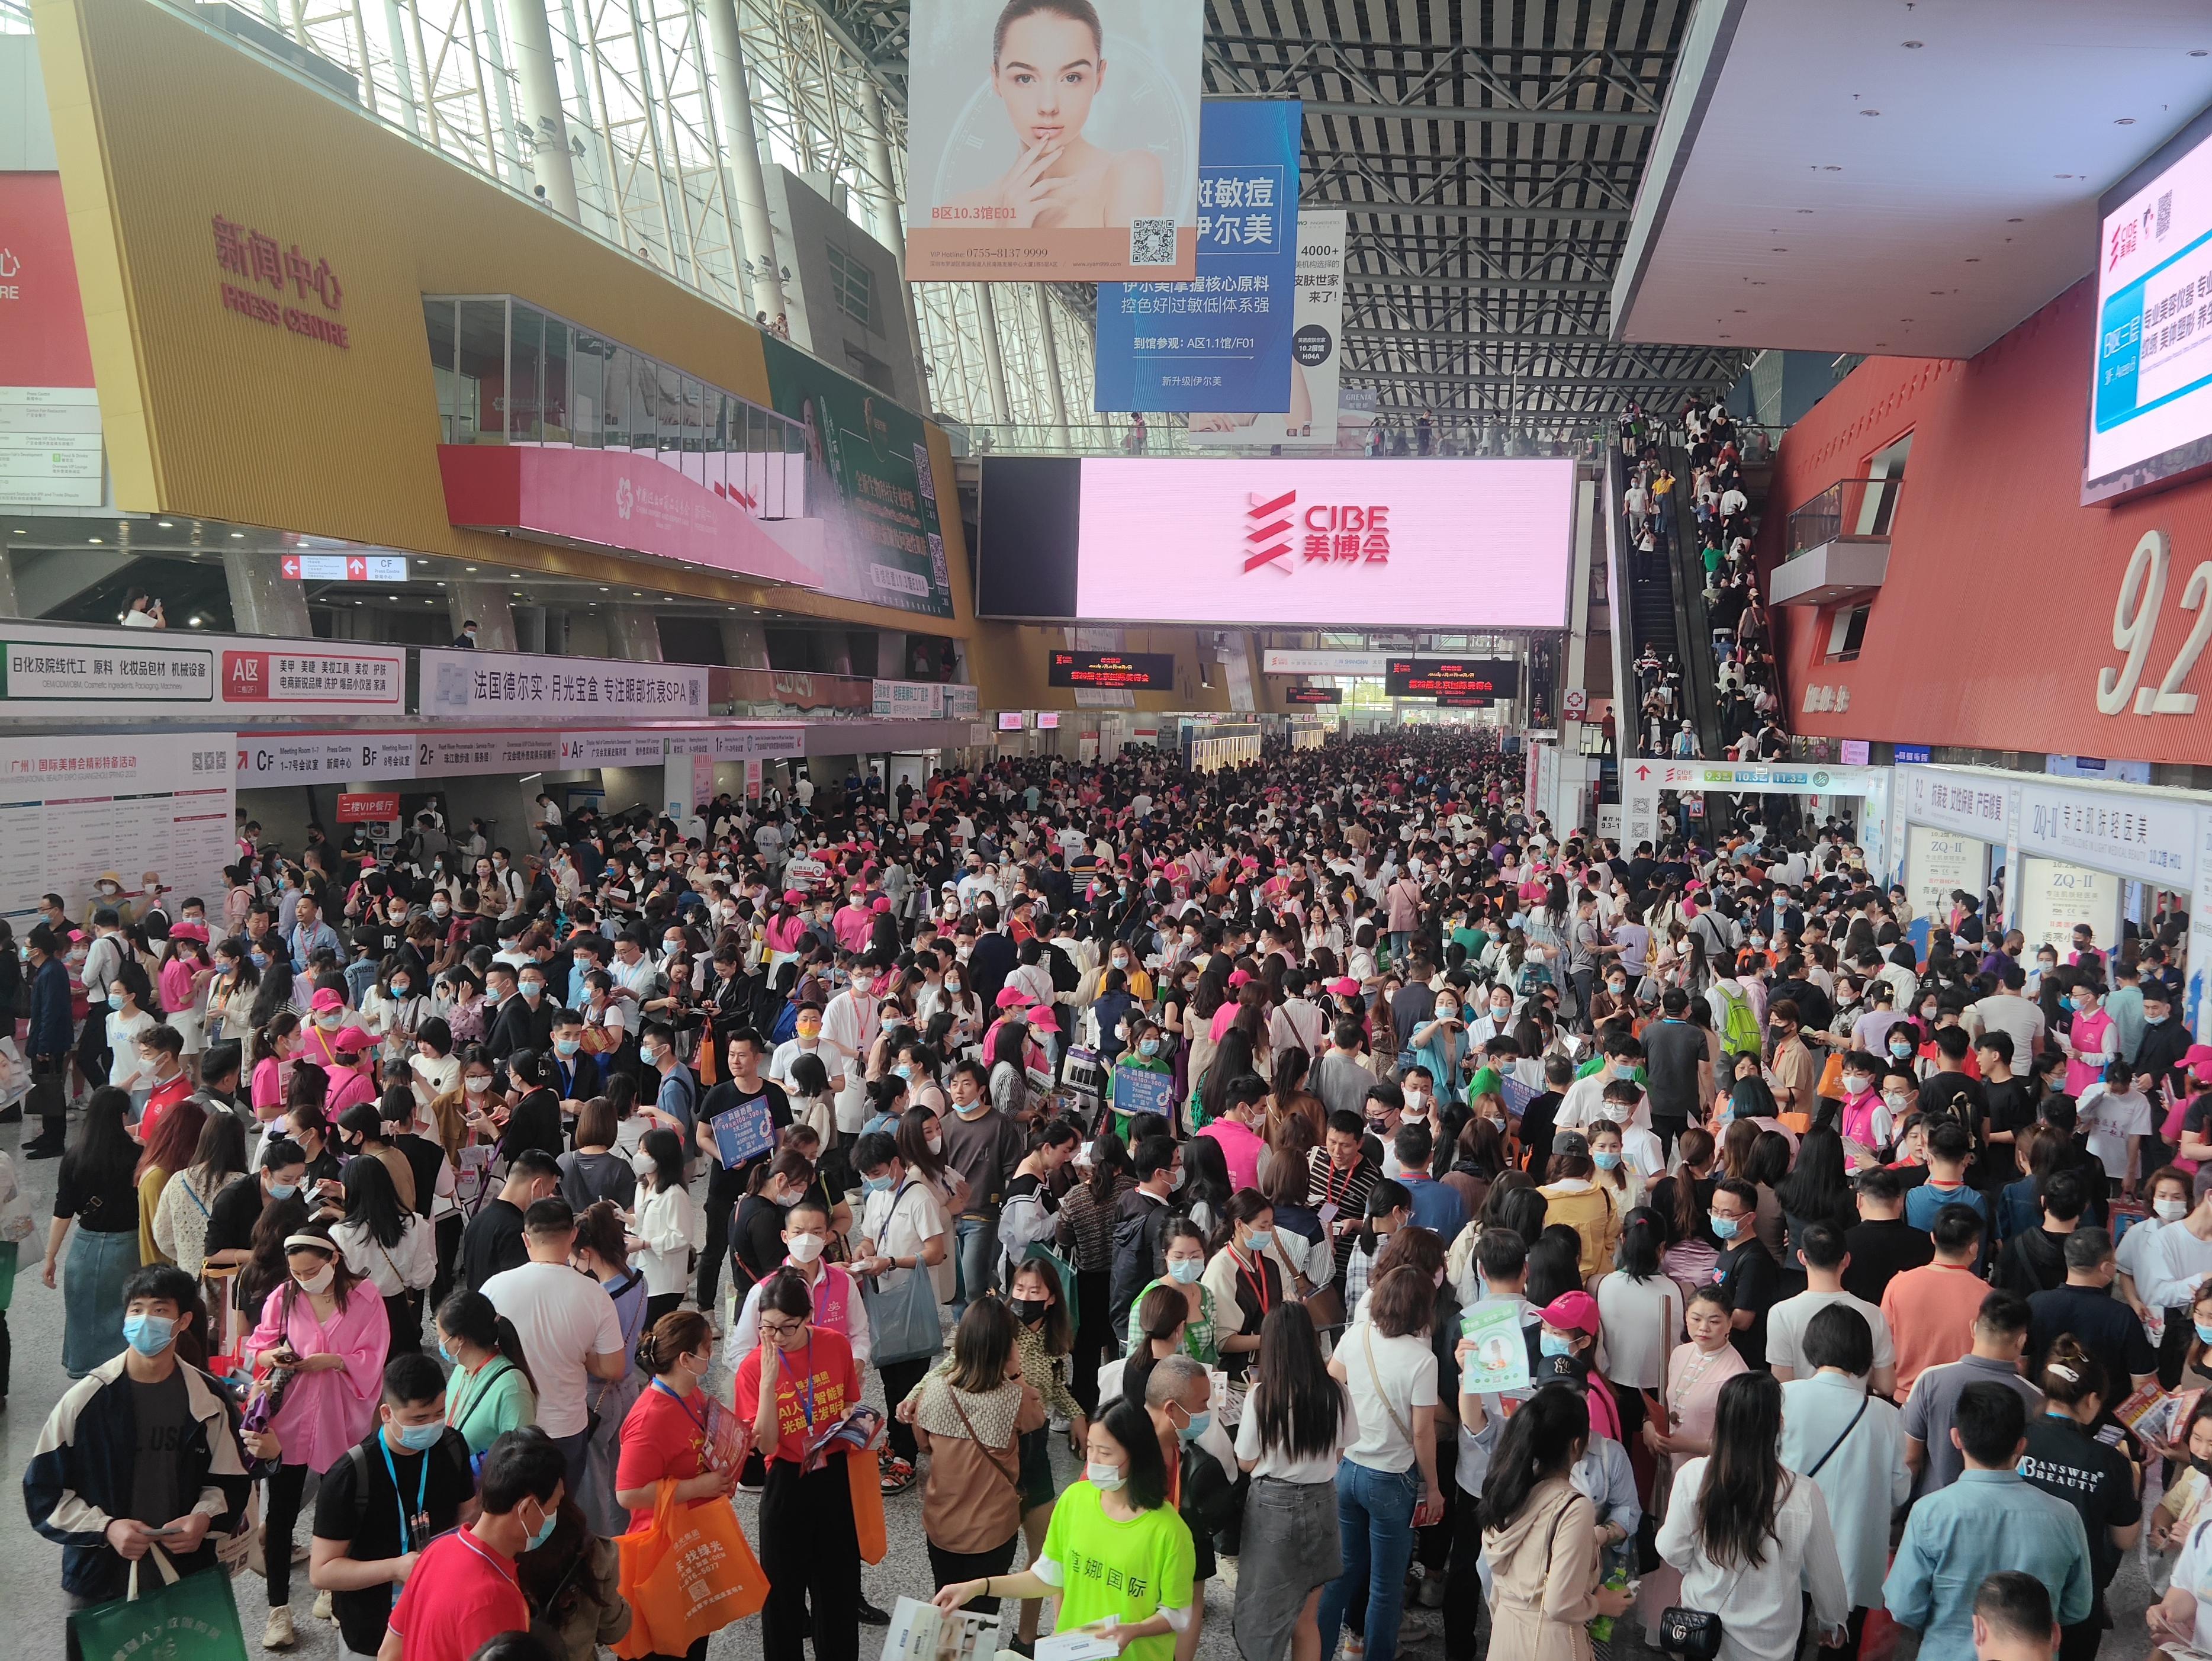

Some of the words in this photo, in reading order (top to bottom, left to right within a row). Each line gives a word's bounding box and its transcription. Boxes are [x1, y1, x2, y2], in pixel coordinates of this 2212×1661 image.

[932, 207, 1017, 220] B区10.3馆E01
[2121, 219, 2137, 242] CIBE
[1024, 248, 1047, 258] 9999
[1301, 245, 1339, 256] 4000+
[211, 214, 342, 310] 新闻中心
[221, 282, 280, 327] PRESS
[284, 307, 349, 349] CENTRE
[2104, 315, 2141, 358] B区三层
[1305, 506, 1390, 532] CIBE
[1303, 534, 1390, 562] 美博会
[381, 560, 393, 568] CF
[13, 657, 86, 674] 日化及院线代工
[94, 660, 113, 675] 原料
[120, 660, 165, 677] 化妆品包材
[172, 662, 205, 677] 机械设备
[233, 658, 258, 681] A区
[280, 660, 294, 673] 美甲
[321, 661, 349, 674] 美妆工具
[355, 663, 368, 675] 美妆
[374, 663, 386, 676] 护肤
[280, 676, 322, 689] 电商新锐品牌
[324, 677, 337, 690] 洗护
[374, 679, 386, 691] 家清
[604, 679, 686, 703] 专注眼部抗衰SPA
[363, 747, 377, 766] BF
[420, 744, 433, 765] 2F
[571, 741, 583, 759] AF
[257, 750, 274, 770] CF
[281, 759, 319, 770] 1-7号会议室
[327, 759, 352, 769] 新闻中心
[1706, 772, 1722, 780] 9.3
[1738, 773, 1758, 782] 10.3
[1776, 774, 1796, 782] 11.3
[342, 800, 393, 812] 二楼VIP餐厅
[1932, 783, 1948, 808] 抗衰老
[1950, 786, 1973, 815] 女性保健
[1976, 791, 2002, 821] 产后修复
[2034, 805, 2057, 840] ZQ-II
[2064, 804, 2146, 844] 专注肌肤轻医美
[1931, 841, 1962, 853] ZQ-II
[2053, 873, 2093, 888] ZQ-II
[2046, 891, 2098, 899] 专注肌肤轻医美
[383, 935, 396, 949] DG
[2037, 1460, 2098, 1483] ANSWER
[2036, 1470, 2098, 1493] BEAUTY
